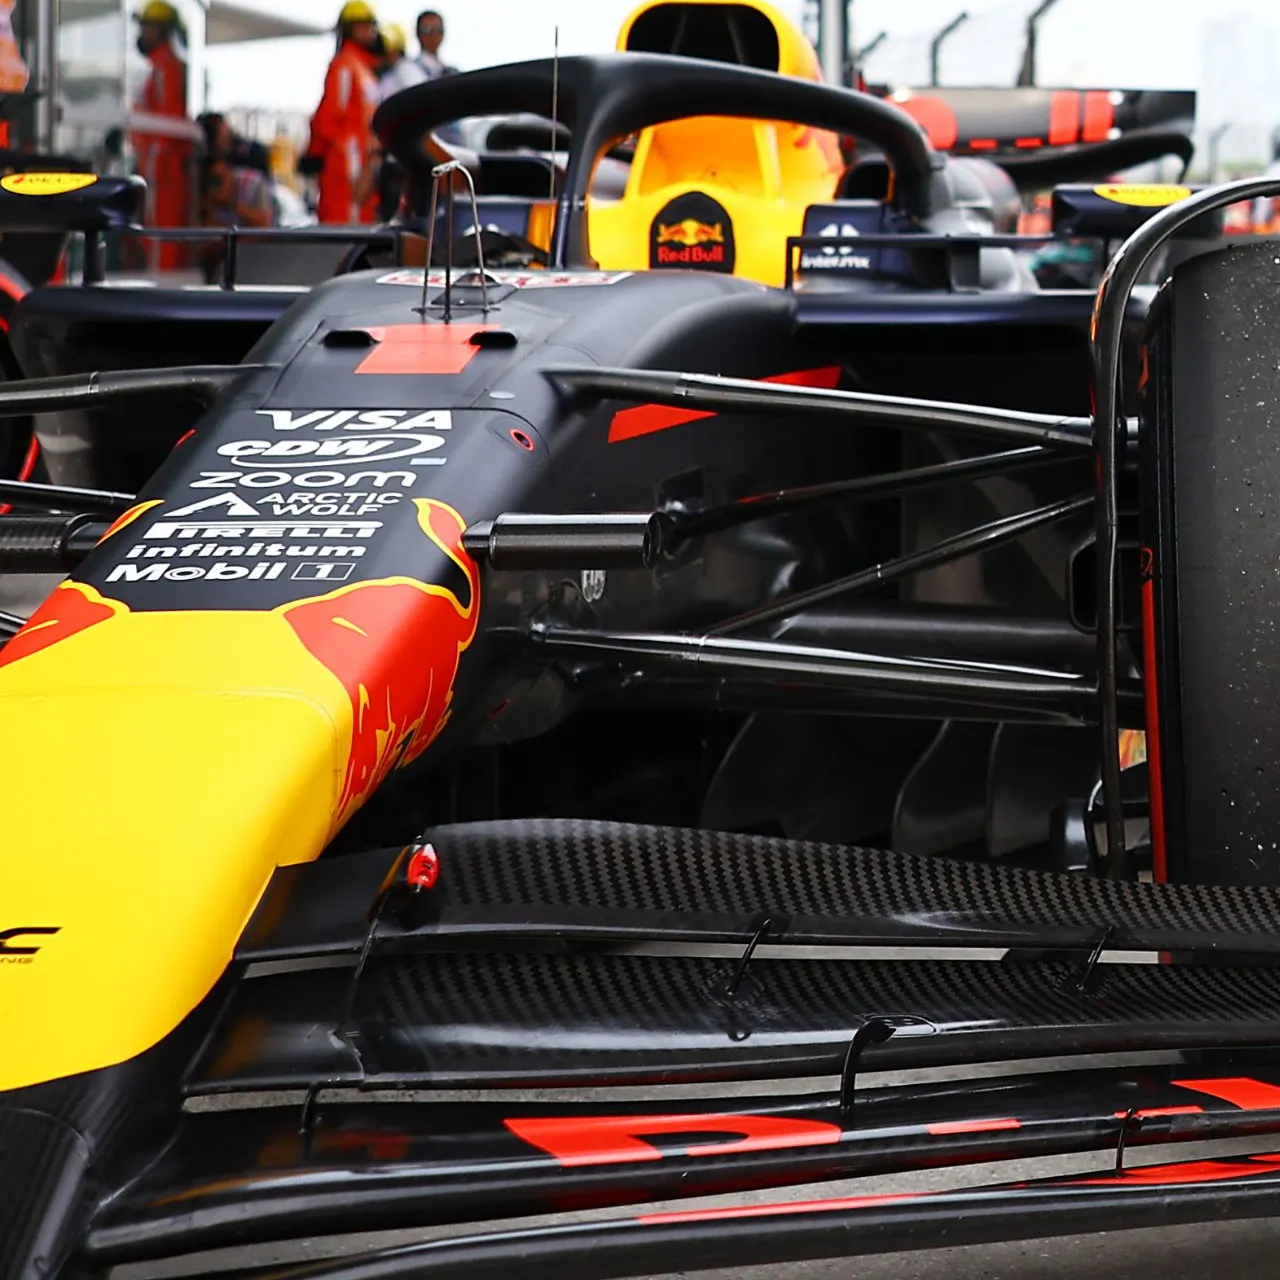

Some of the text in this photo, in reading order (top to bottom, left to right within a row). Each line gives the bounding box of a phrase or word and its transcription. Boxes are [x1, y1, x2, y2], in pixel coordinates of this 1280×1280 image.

[657, 245, 724, 263] Red Bull
[255, 410, 452, 430] VISA
[189, 471, 418, 488] zoom
[255, 492, 404, 505] ARCTIC
[270, 504, 383, 516] WOLF
[142, 521, 384, 539] PIRELLI
[125, 543, 367, 559] infinitum
[104, 562, 288, 582] Mobil
